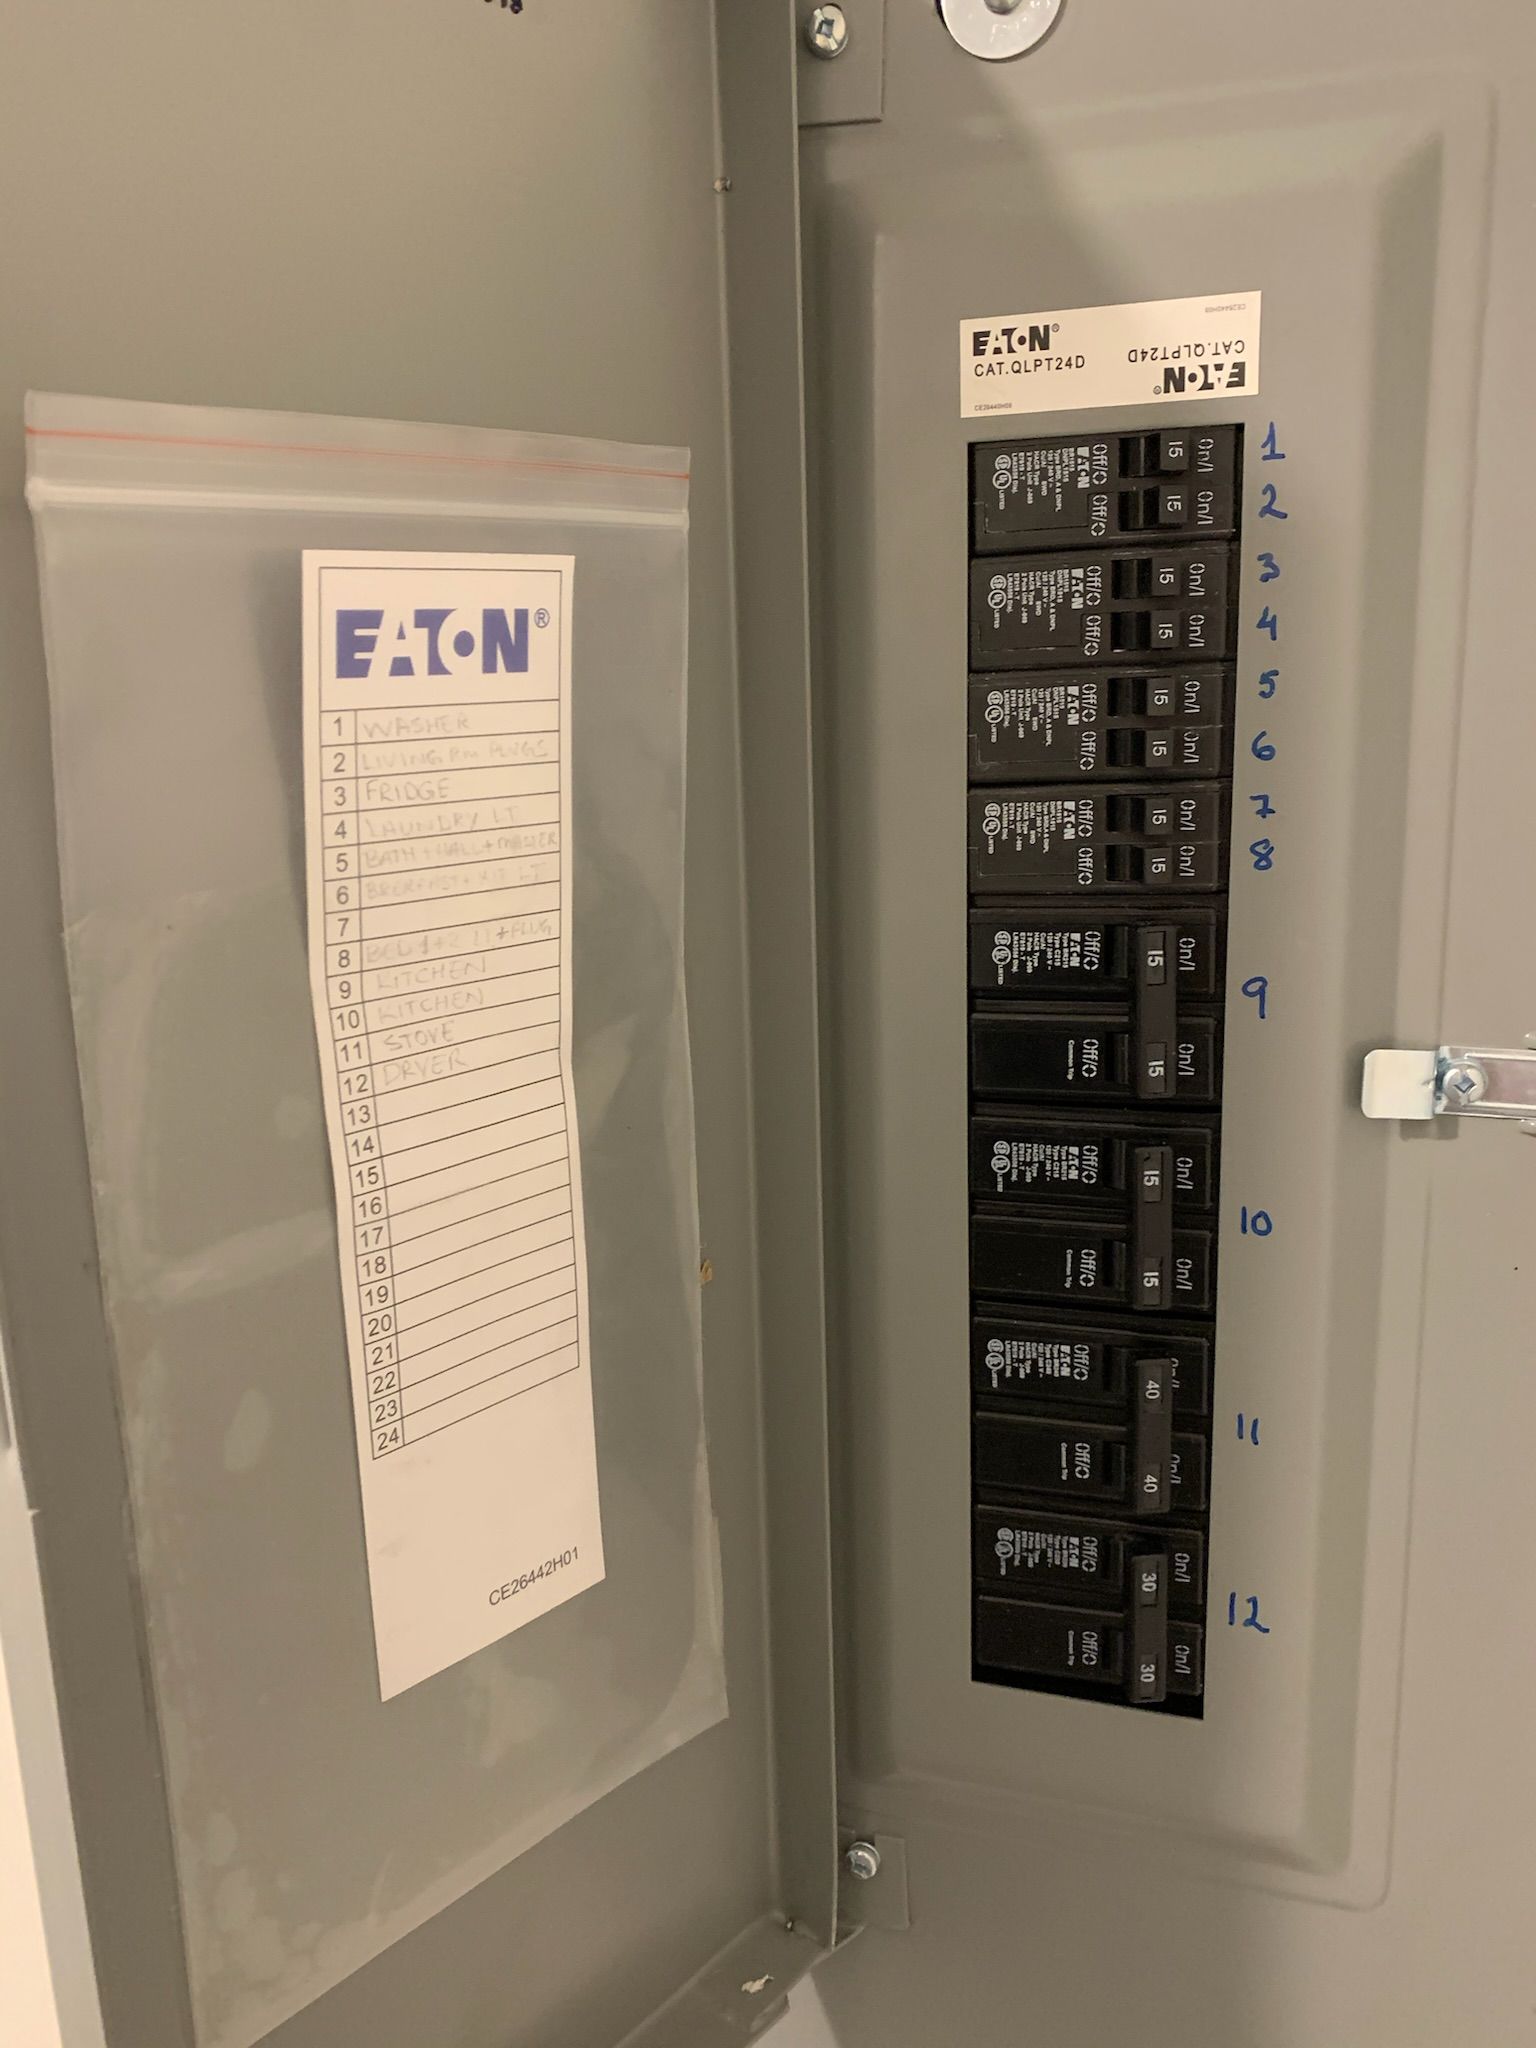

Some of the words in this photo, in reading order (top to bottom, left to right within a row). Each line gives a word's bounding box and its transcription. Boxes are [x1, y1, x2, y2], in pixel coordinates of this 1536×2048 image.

[972, 324, 1051, 357] EATON
[1128, 340, 1244, 362] CAT.QLPT24D
[975, 356, 1084, 376] CAT.QLPT24D
[1162, 361, 1247, 394] EATON
[1169, 442, 1182, 457] 15
[1261, 422, 1286, 460] 1
[1167, 496, 1181, 511] 15
[1258, 483, 1288, 520] 2
[1160, 569, 1173, 583] 15
[1257, 553, 1280, 583] 3
[1159, 624, 1172, 638] 15
[1256, 606, 1277, 641] 4
[336, 607, 530, 679] EATON
[1258, 669, 1279, 699] 5
[1155, 690, 1168, 704] 15
[334, 717, 341, 736] 1
[363, 711, 471, 739] WASHER
[1153, 741, 1166, 756] 15
[1251, 731, 1276, 761] 6
[334, 753, 345, 772] 2
[361, 750, 443, 770] LIVING
[335, 787, 346, 806] 3
[366, 778, 450, 803] FRIDGE
[1250, 794, 1276, 818] 7
[365, 812, 479, 838] LAUNDRY
[1153, 810, 1166, 824] 15
[335, 820, 347, 839] 4
[337, 853, 348, 872] 5
[1250, 839, 1275, 871] 8
[1152, 858, 1165, 873] 15
[337, 886, 349, 904] 6
[338, 918, 349, 936] 7
[339, 950, 350, 968] 8
[1148, 951, 1163, 966] 15
[376, 956, 487, 990] KITCHEN
[339, 981, 351, 999] 9
[1242, 976, 1269, 1018] 9
[378, 987, 485, 1022] KITCHEN
[337, 1010, 359, 1030] 10
[384, 1020, 455, 1052] STOVE
[341, 1042, 361, 1062] 11
[382, 1048, 470, 1087] DRYER
[1149, 1061, 1164, 1077] 15
[344, 1074, 368, 1095] 12
[348, 1105, 370, 1125] 13
[352, 1136, 374, 1156] 14
[356, 1166, 378, 1187] 15
[1144, 1171, 1159, 1186] 15
[359, 1197, 381, 1217] 16
[1240, 1206, 1273, 1237] 10
[361, 1226, 383, 1247] 17
[363, 1256, 386, 1276] 18
[1144, 1272, 1158, 1287] 15
[365, 1286, 388, 1306] 19
[368, 1314, 392, 1337] 20
[371, 1343, 395, 1366] 21
[373, 1371, 396, 1395] 22
[1146, 1381, 1160, 1399] 40
[375, 1400, 398, 1424] 23
[377, 1427, 400, 1452] 24
[1236, 1413, 1260, 1446] 11
[1144, 1475, 1157, 1492] 40
[488, 1546, 579, 1606] CE26442H01
[1142, 1573, 1156, 1591] 30
[1228, 1591, 1270, 1633] 12
[1141, 1665, 1155, 1682] 30
